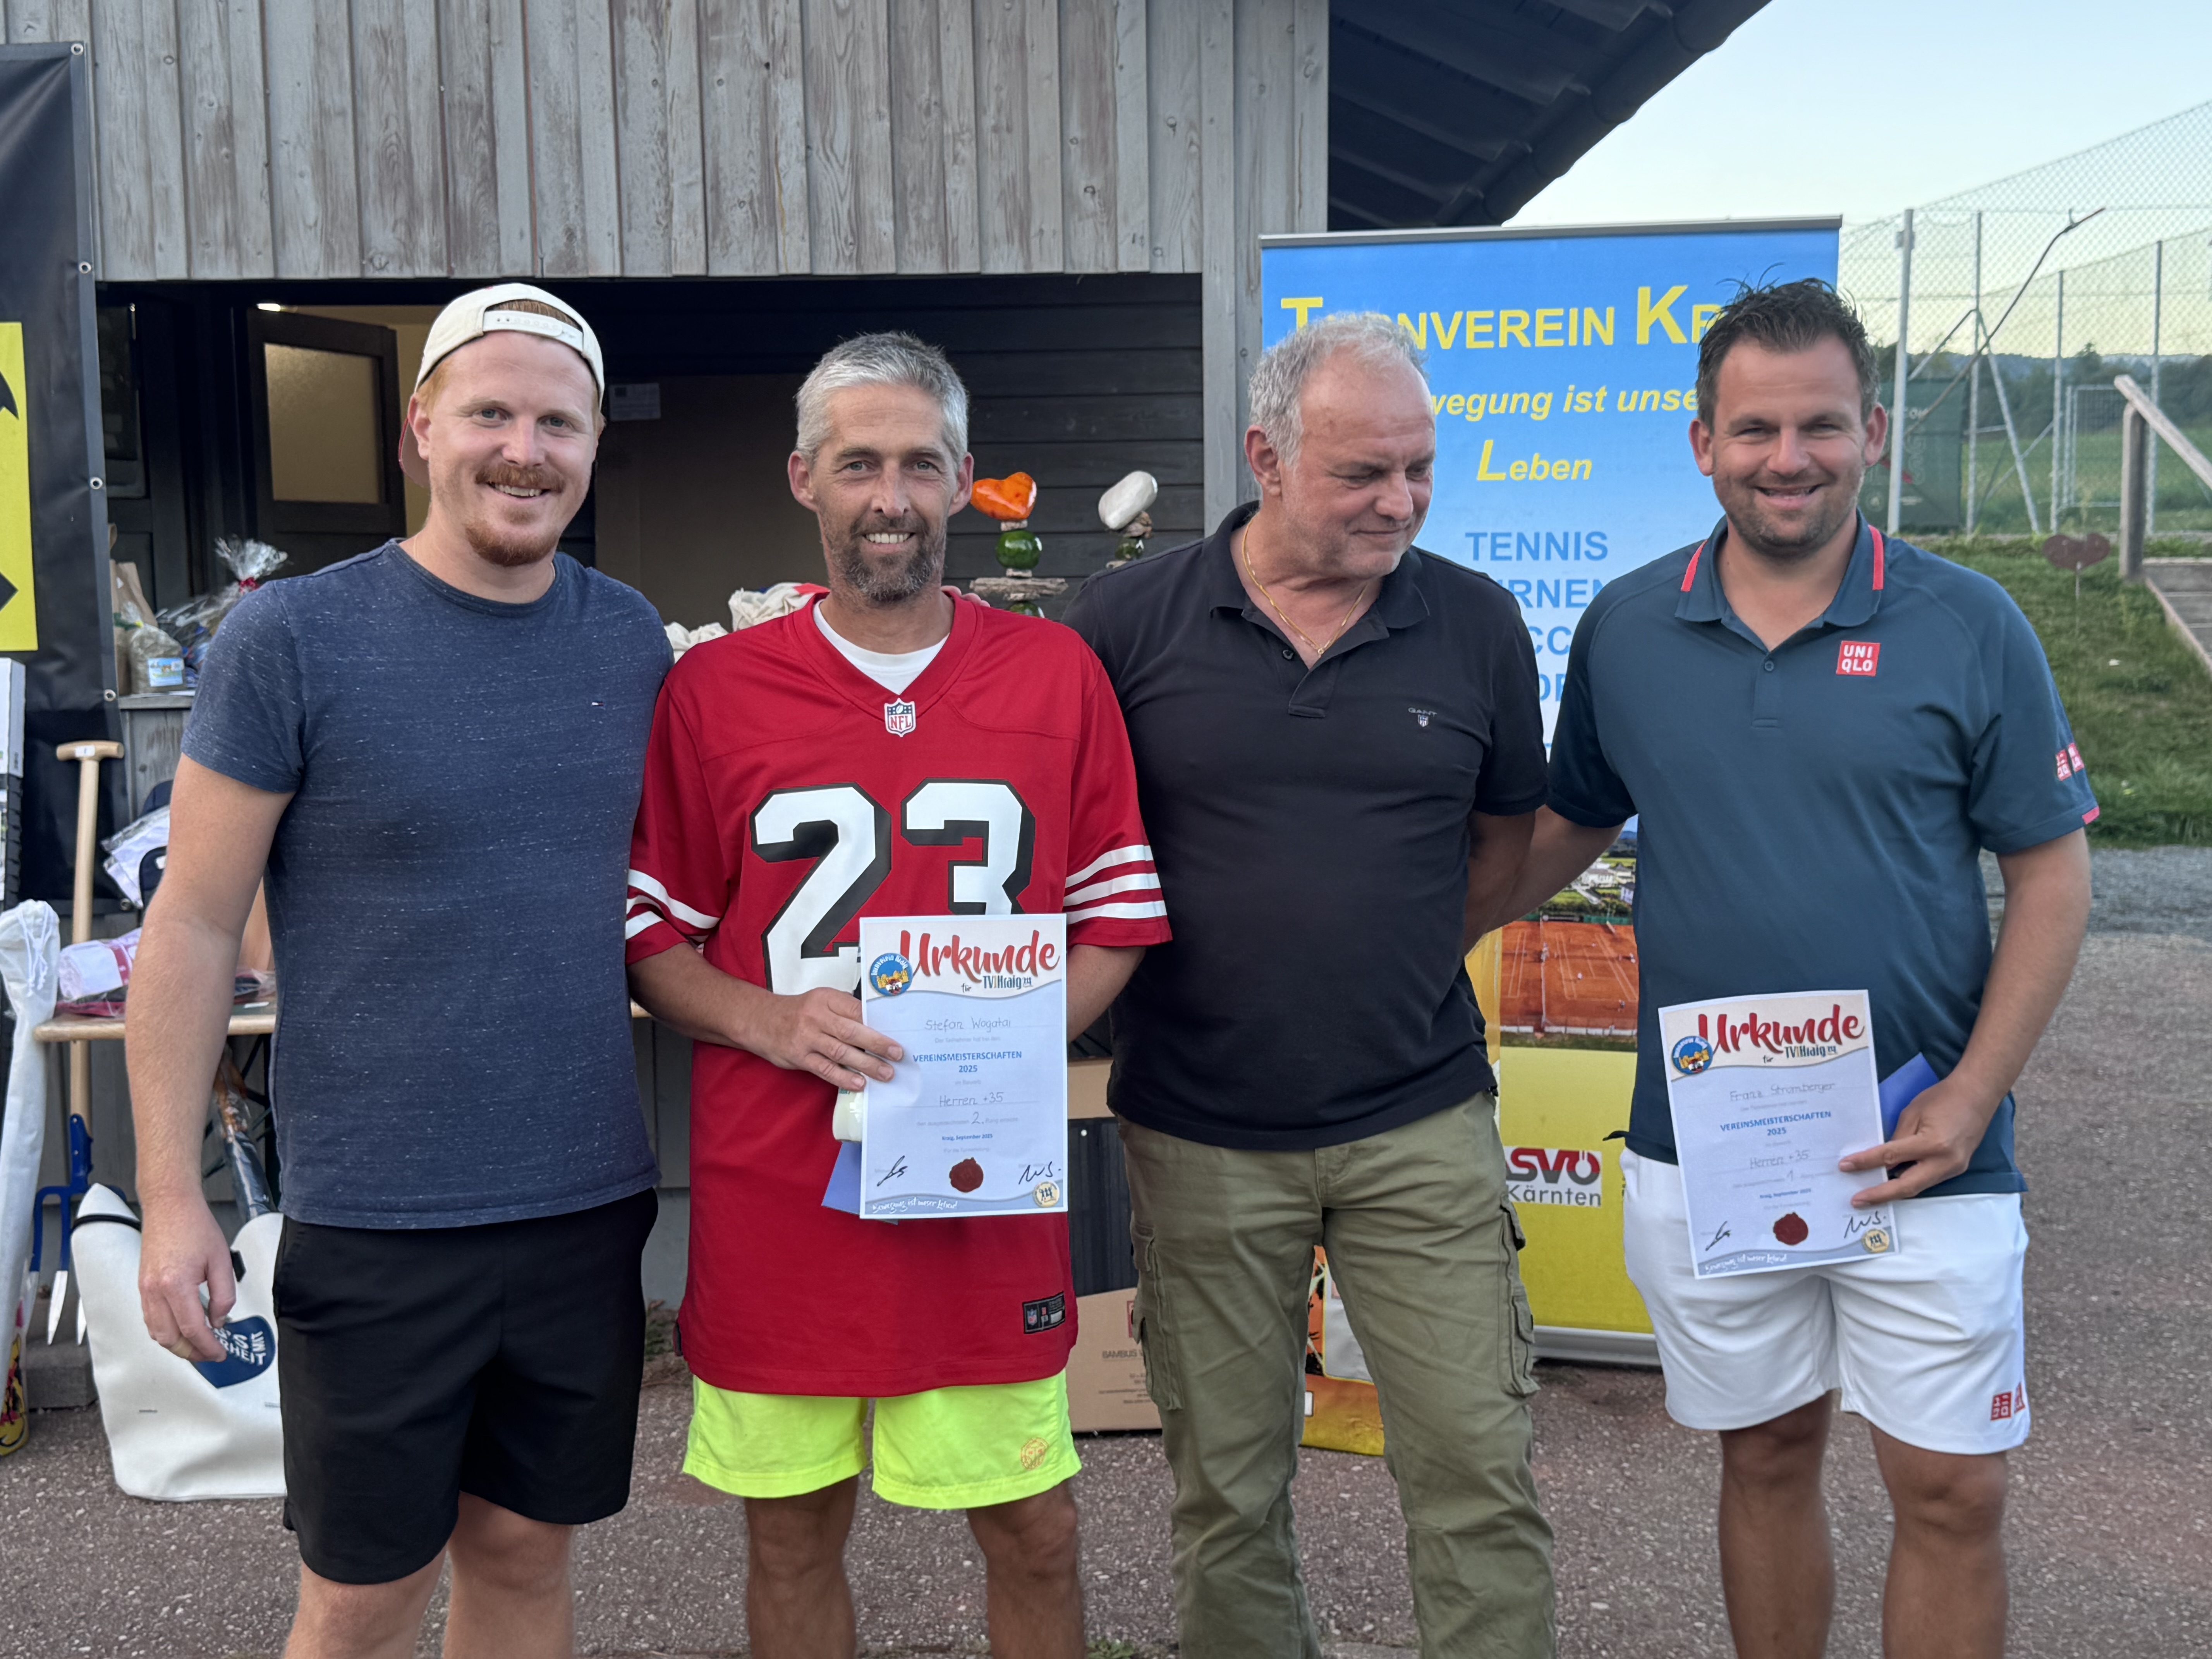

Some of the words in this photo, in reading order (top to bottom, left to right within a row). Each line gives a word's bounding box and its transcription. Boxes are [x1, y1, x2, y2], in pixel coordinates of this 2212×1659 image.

[1281, 297, 1614, 350] TNVEREIN
[1563, 385, 1607, 413] ist
[1616, 388, 1699, 412] unse
[1476, 439, 1592, 481] Leben
[1465, 531, 1608, 561] TENNIS
[1843, 644, 1873, 658] UNI
[1841, 658, 1873, 673] QLO
[890, 715, 911, 730] NFL
[749, 777, 1036, 996] 23
[900, 929, 1060, 983] Urkunde
[1698, 1004, 1865, 1054] Urkunde
[912, 1051, 1022, 1062] VEREINSMEISTERSCHAFTEN
[939, 1095, 978, 1107] Herren
[1720, 1111, 1832, 1132] VEREINSMEISTERSCHAFTEN
[1767, 1127, 1786, 1136] 2025
[1506, 1148, 1600, 1185] SVÖ
[1750, 1157, 1784, 1169] Herren
[1508, 1184, 1601, 1207] Kärnten
